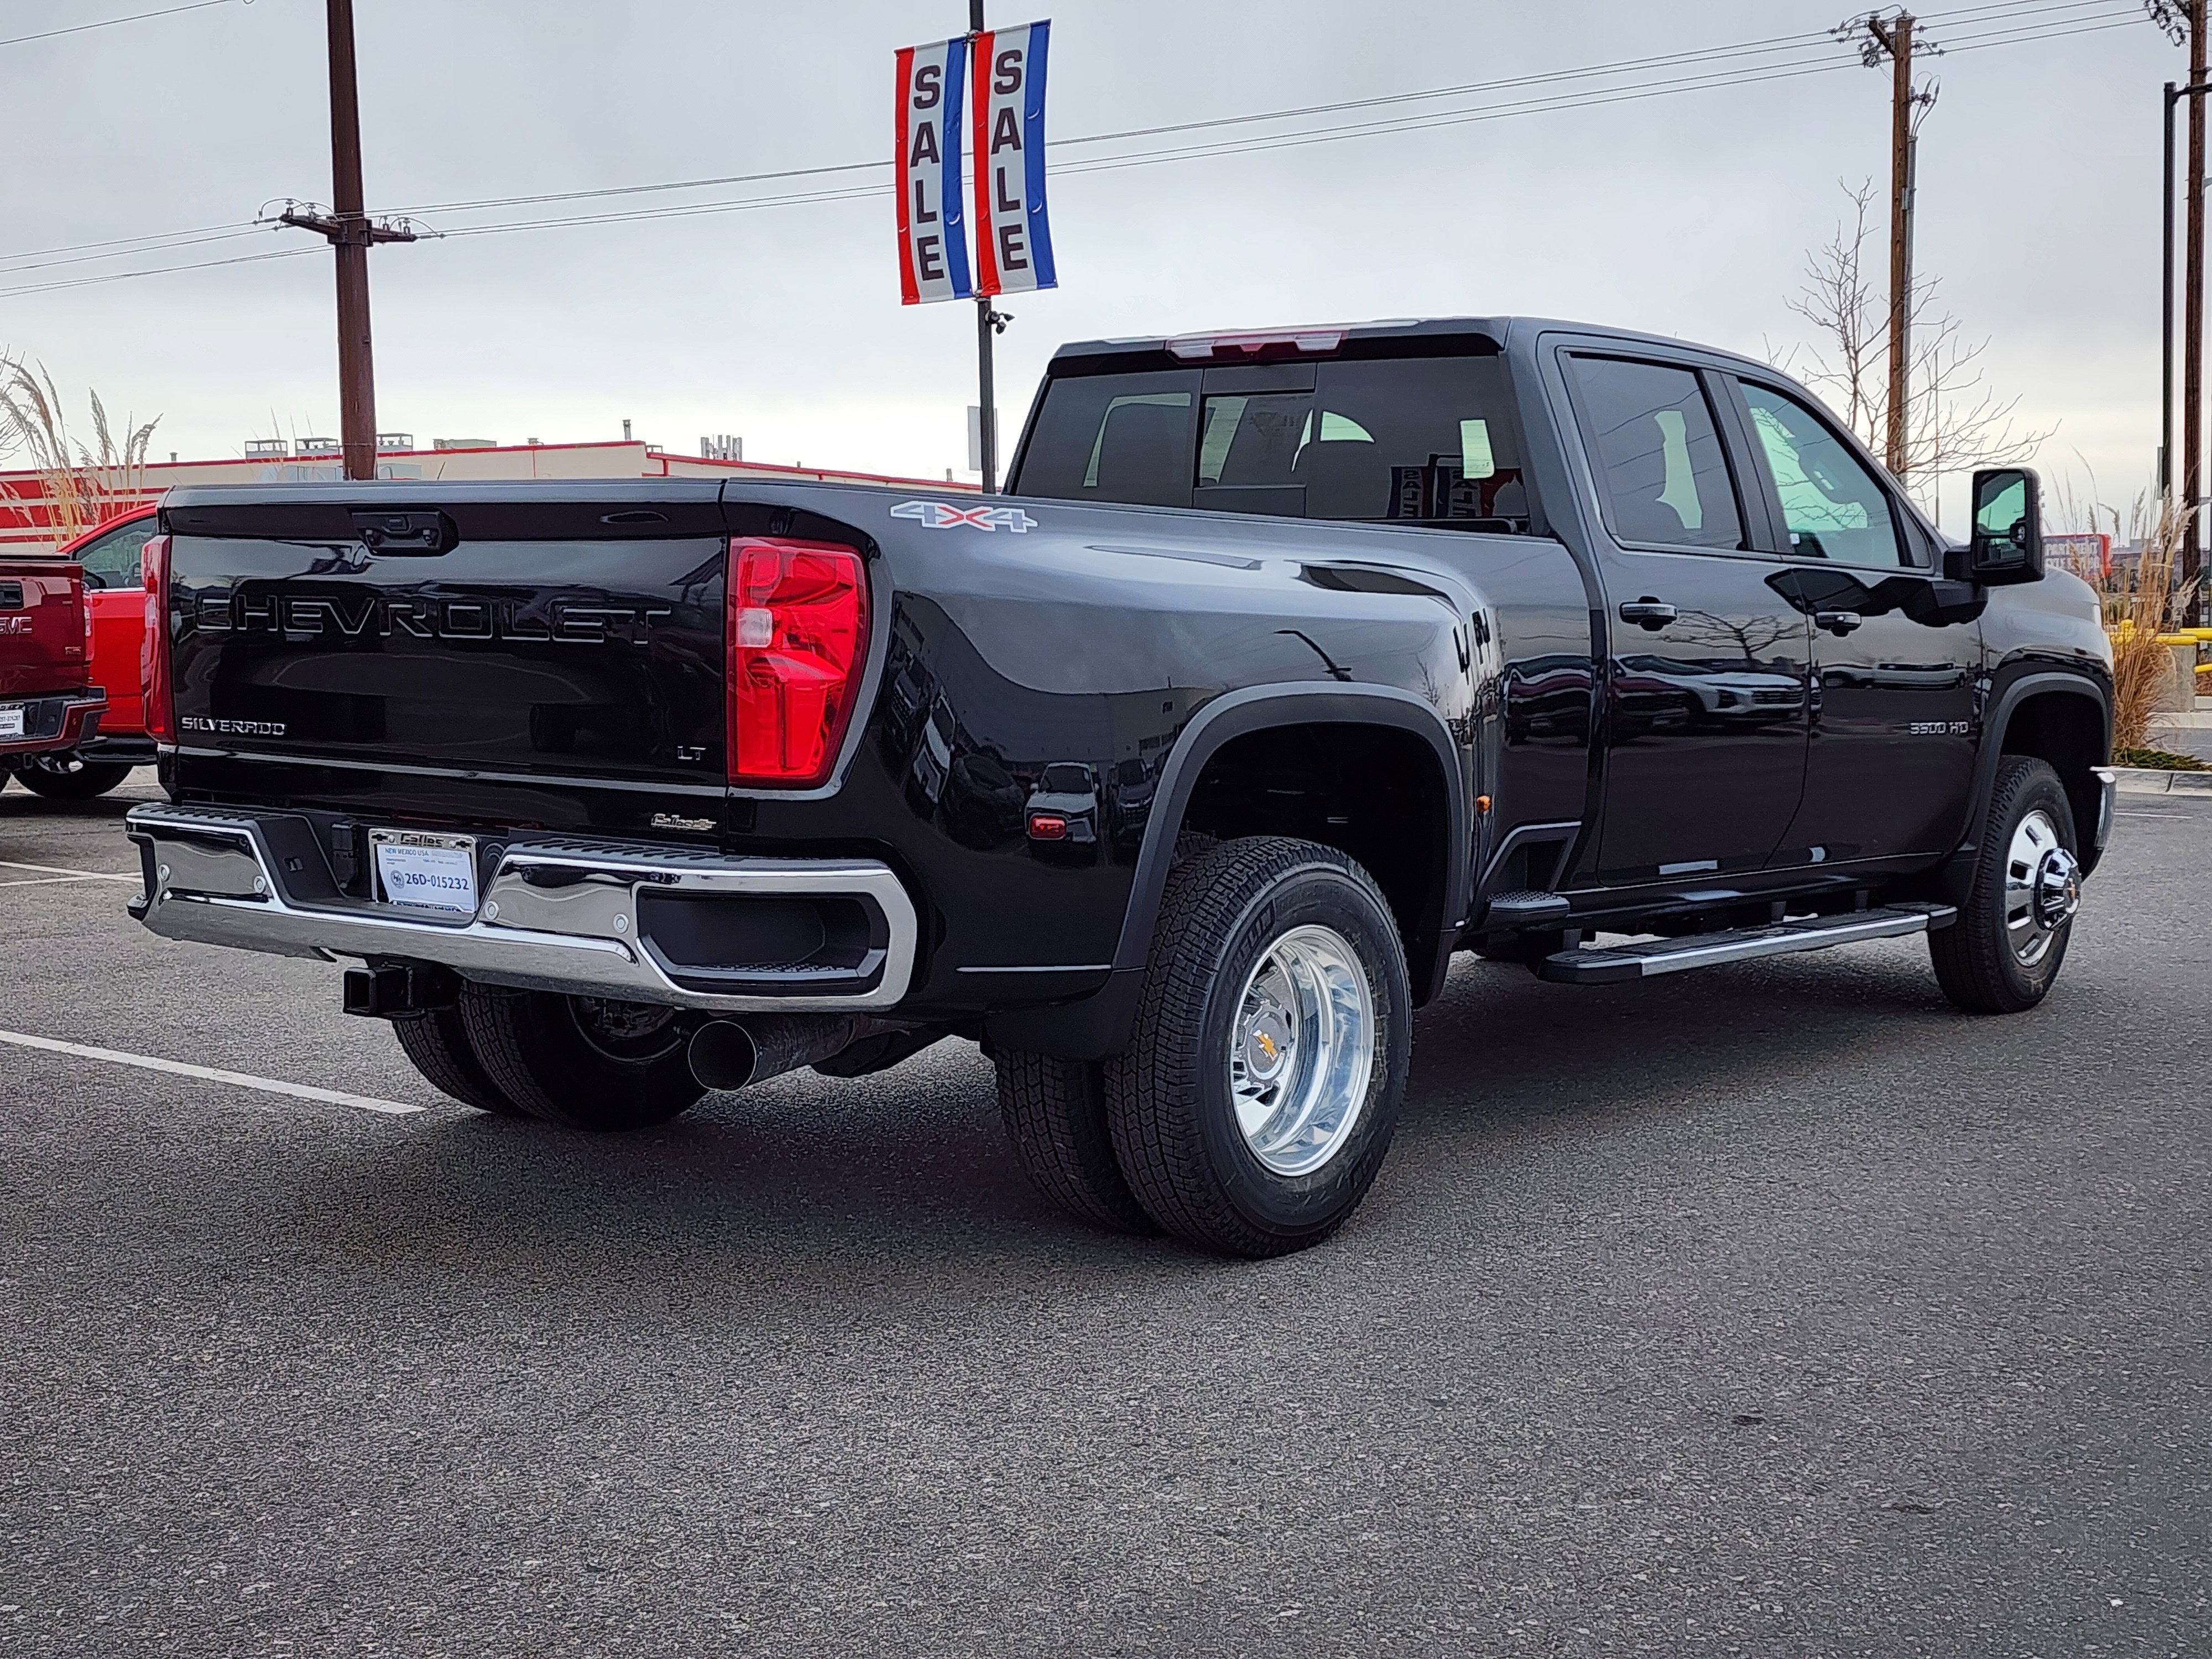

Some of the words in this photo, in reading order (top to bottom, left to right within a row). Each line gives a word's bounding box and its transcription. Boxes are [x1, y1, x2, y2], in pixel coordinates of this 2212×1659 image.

[990, 49, 1028, 271] SALE
[910, 65, 945, 281] SALE
[891, 500, 1038, 533] 4X4
[195, 593, 671, 646] CHEVROLET
[181, 717, 286, 735] SILVERADO
[1910, 722, 1946, 734] 3500
[1949, 721, 1969, 734] HD
[677, 746, 707, 760] LT
[405, 873, 469, 890] 26D-015232
